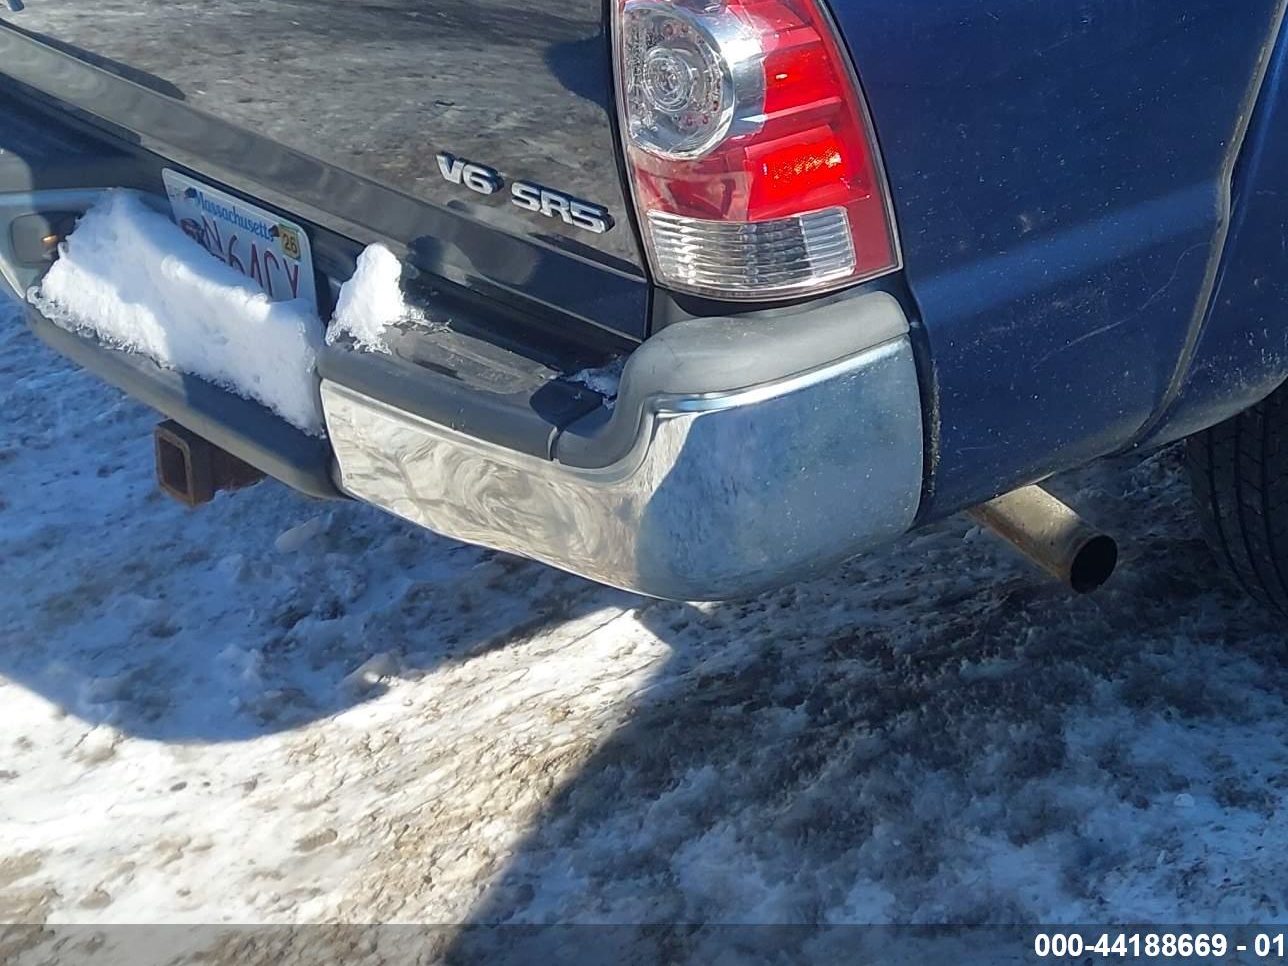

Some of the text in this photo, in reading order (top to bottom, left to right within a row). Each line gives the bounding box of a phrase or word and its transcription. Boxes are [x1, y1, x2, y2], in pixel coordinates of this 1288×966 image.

[435, 152, 615, 234] V6 SR5
[282, 233, 298, 254] 26
